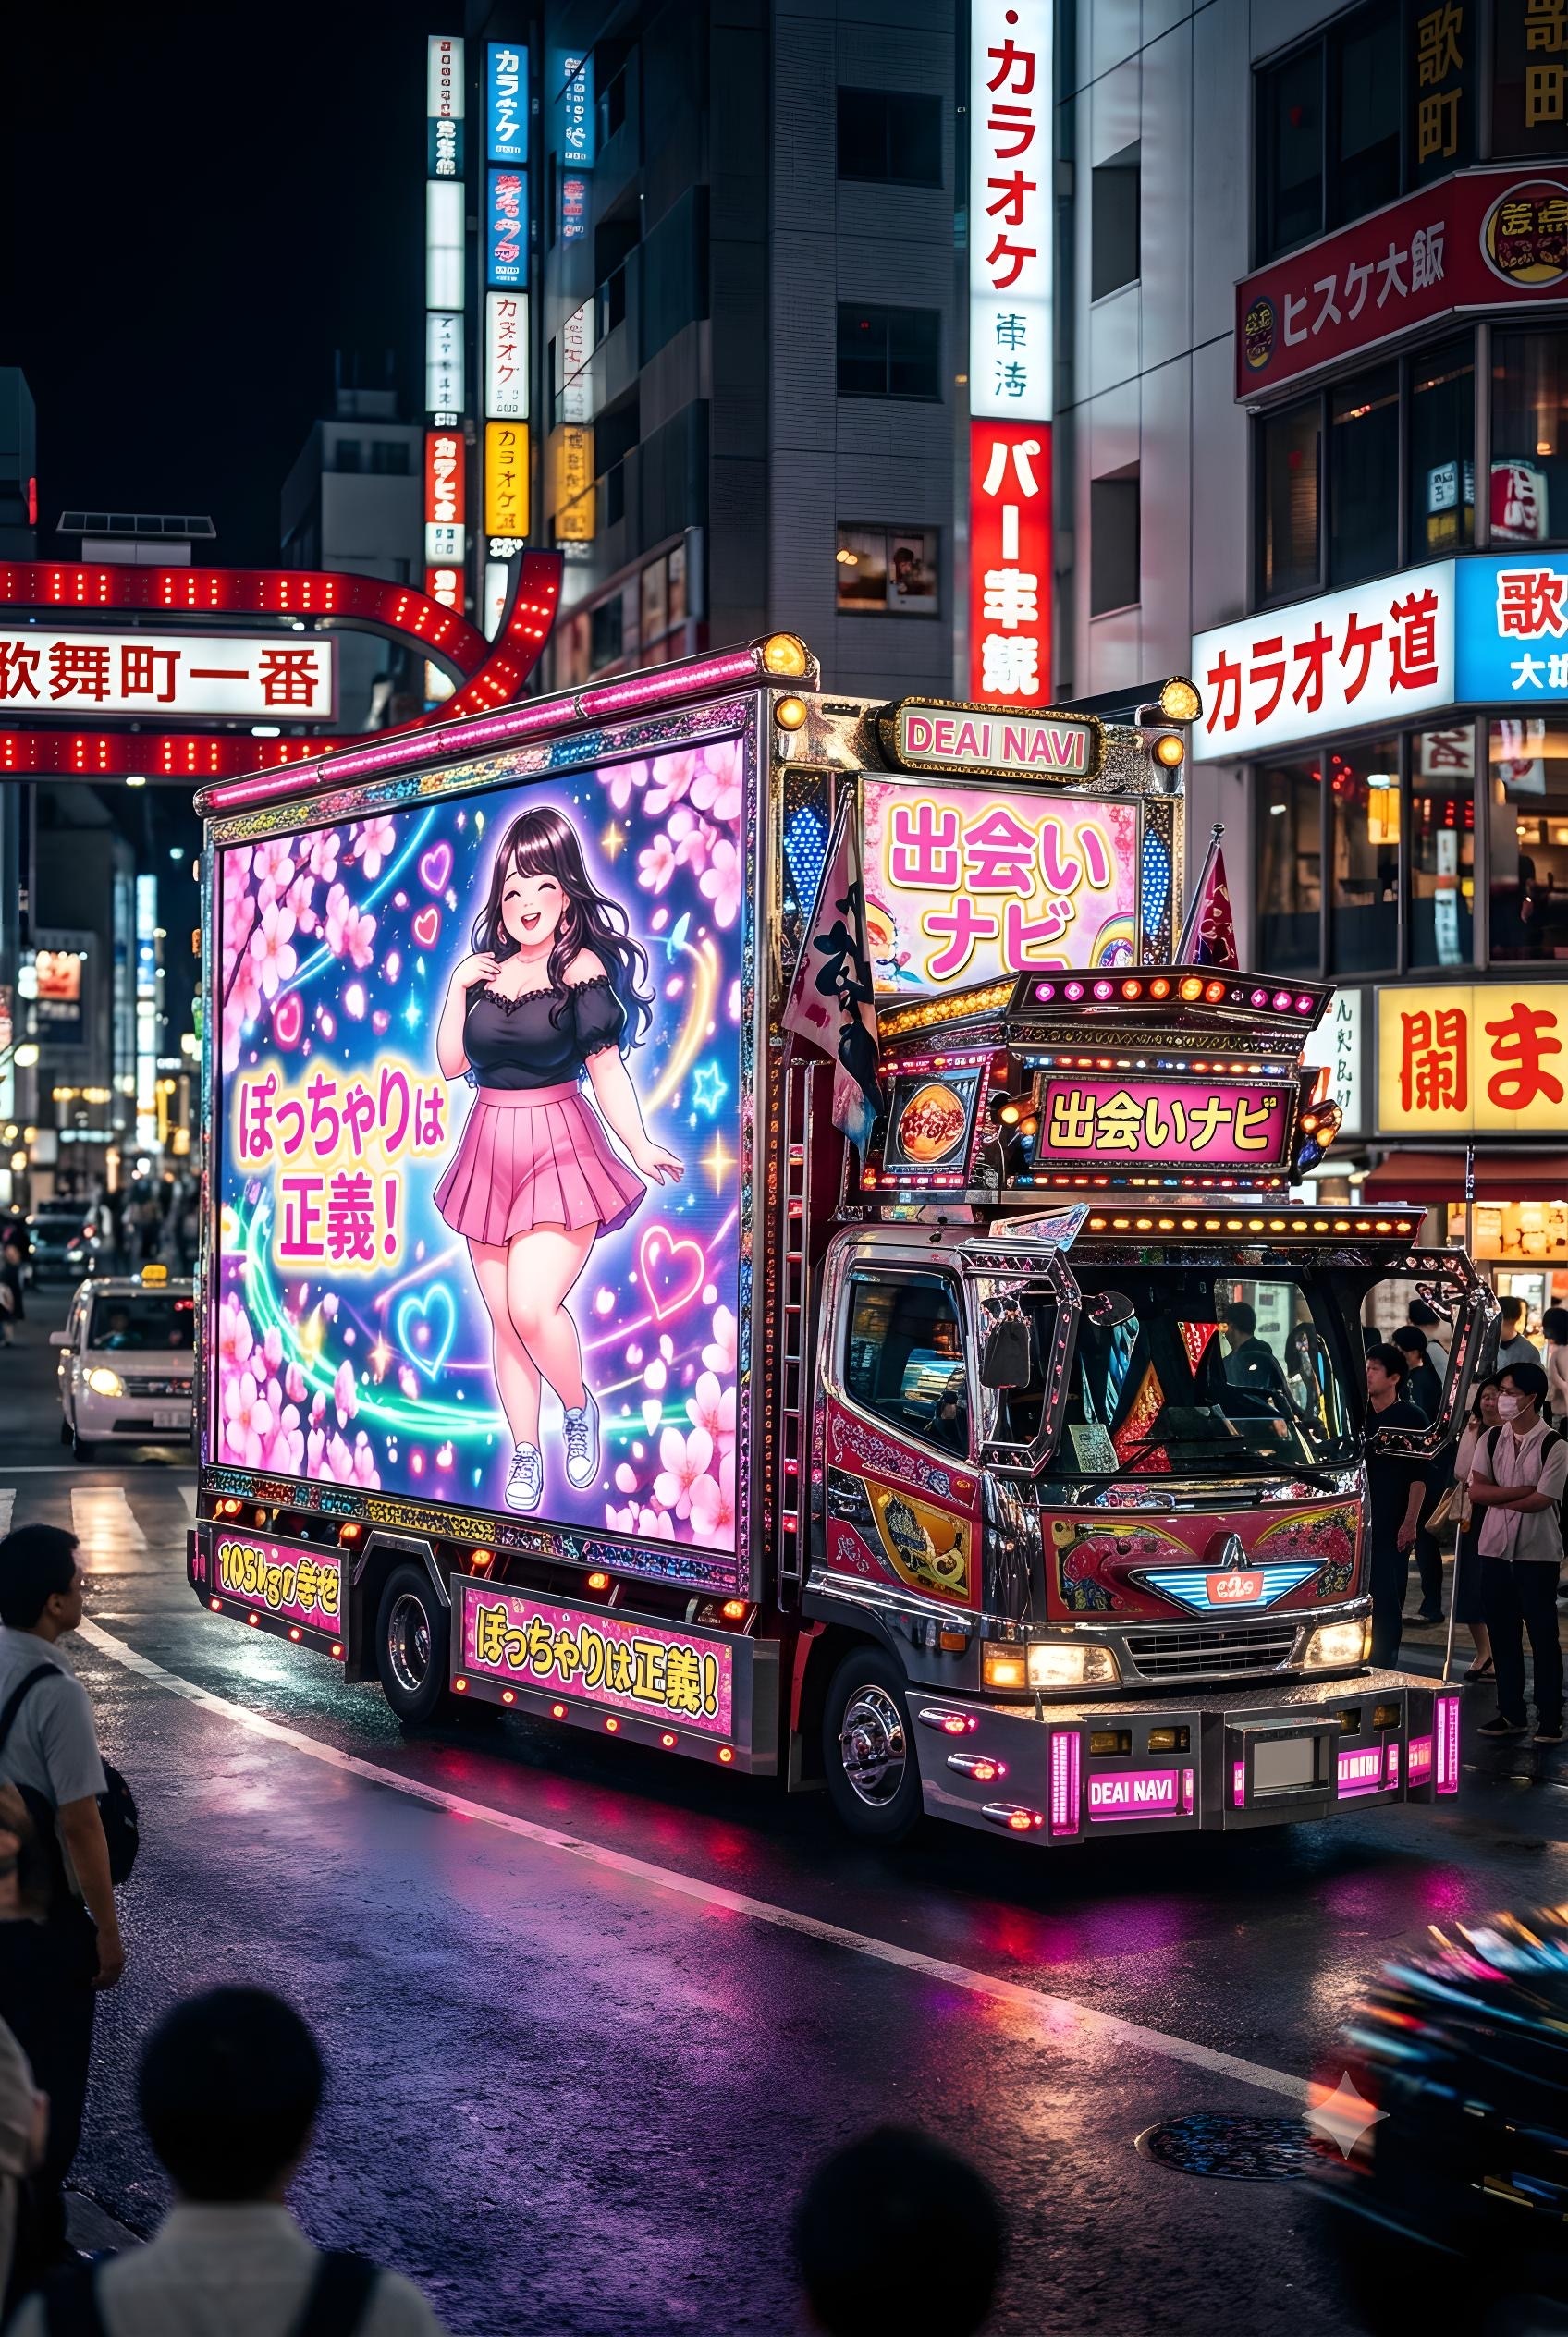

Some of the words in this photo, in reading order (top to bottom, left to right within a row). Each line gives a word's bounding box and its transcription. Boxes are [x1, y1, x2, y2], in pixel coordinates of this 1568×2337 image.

[1206, 588, 1439, 735] カラオケ道
[906, 716, 992, 759] DEAI
[1002, 726, 1085, 769] NAVI
[889, 801, 1111, 898] 出会い
[923, 897, 1075, 981] ナビ
[239, 1066, 446, 1159] ぽっちゃりは
[1048, 1089, 1279, 1152] 出会いナビ
[1091, 1782, 1130, 1805] DEAI
[1133, 1779, 1173, 1802] NAVI
